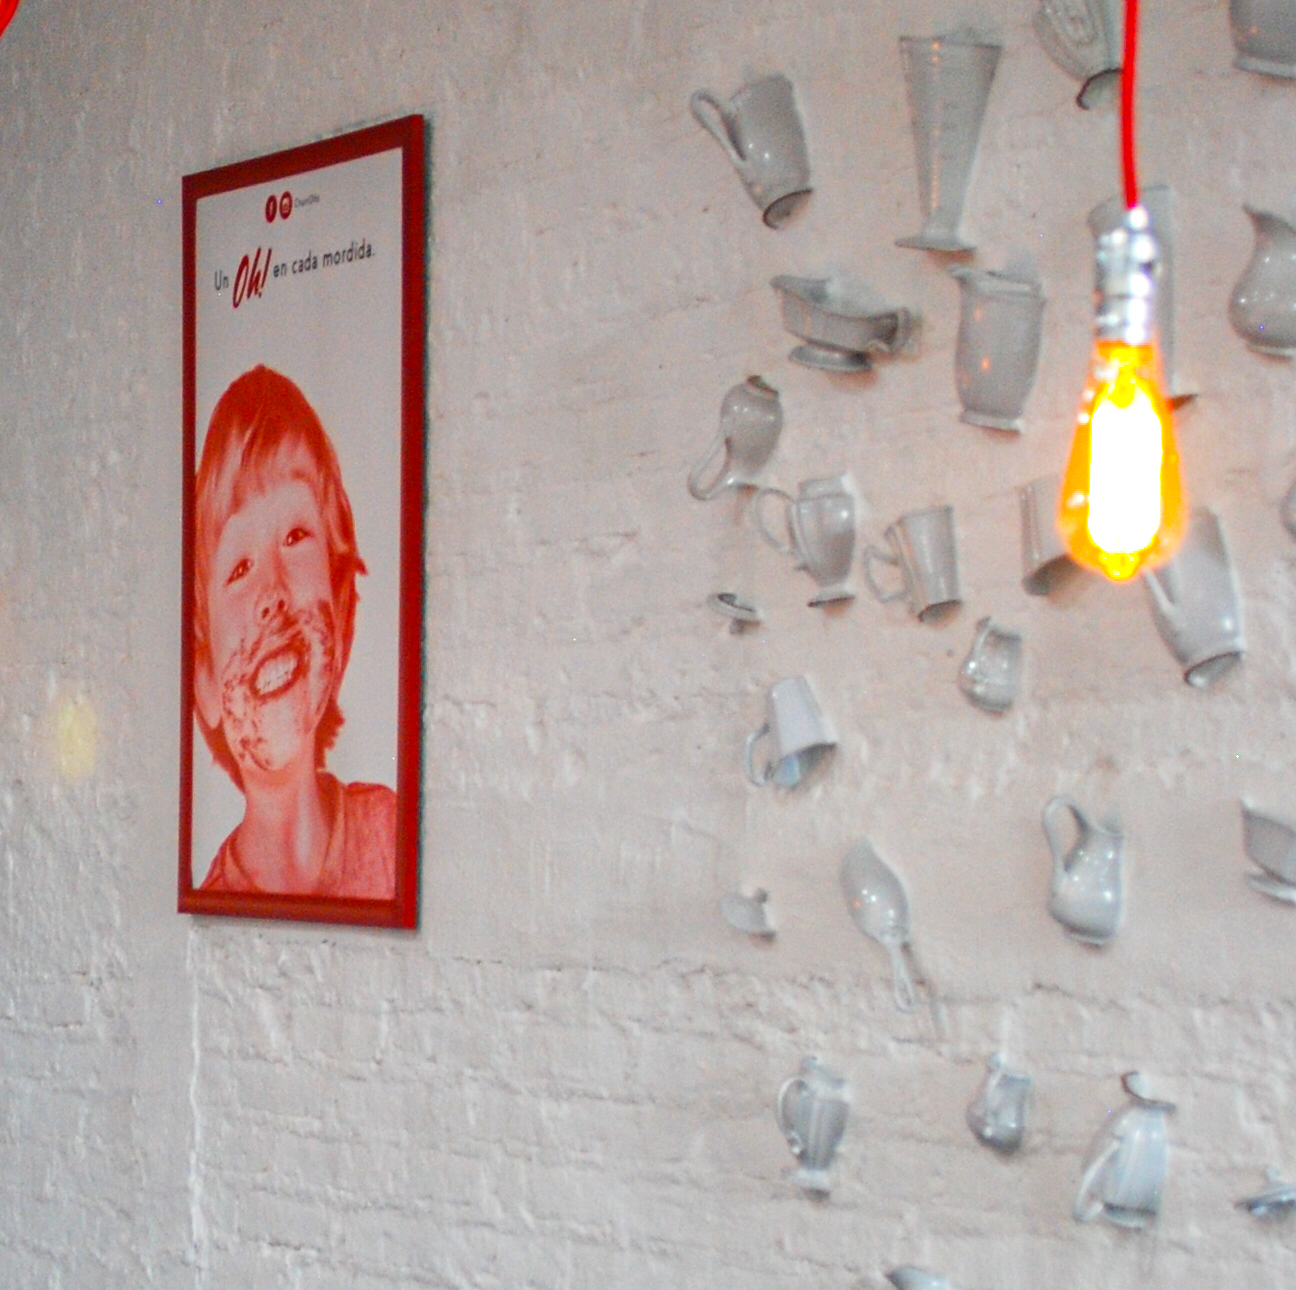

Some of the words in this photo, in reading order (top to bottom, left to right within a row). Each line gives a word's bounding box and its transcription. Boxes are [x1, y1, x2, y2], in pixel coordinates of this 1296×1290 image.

[214, 269, 230, 291] Un
[232, 245, 273, 309] Oh!
[273, 261, 287, 278] en
[291, 249, 319, 275] cada
